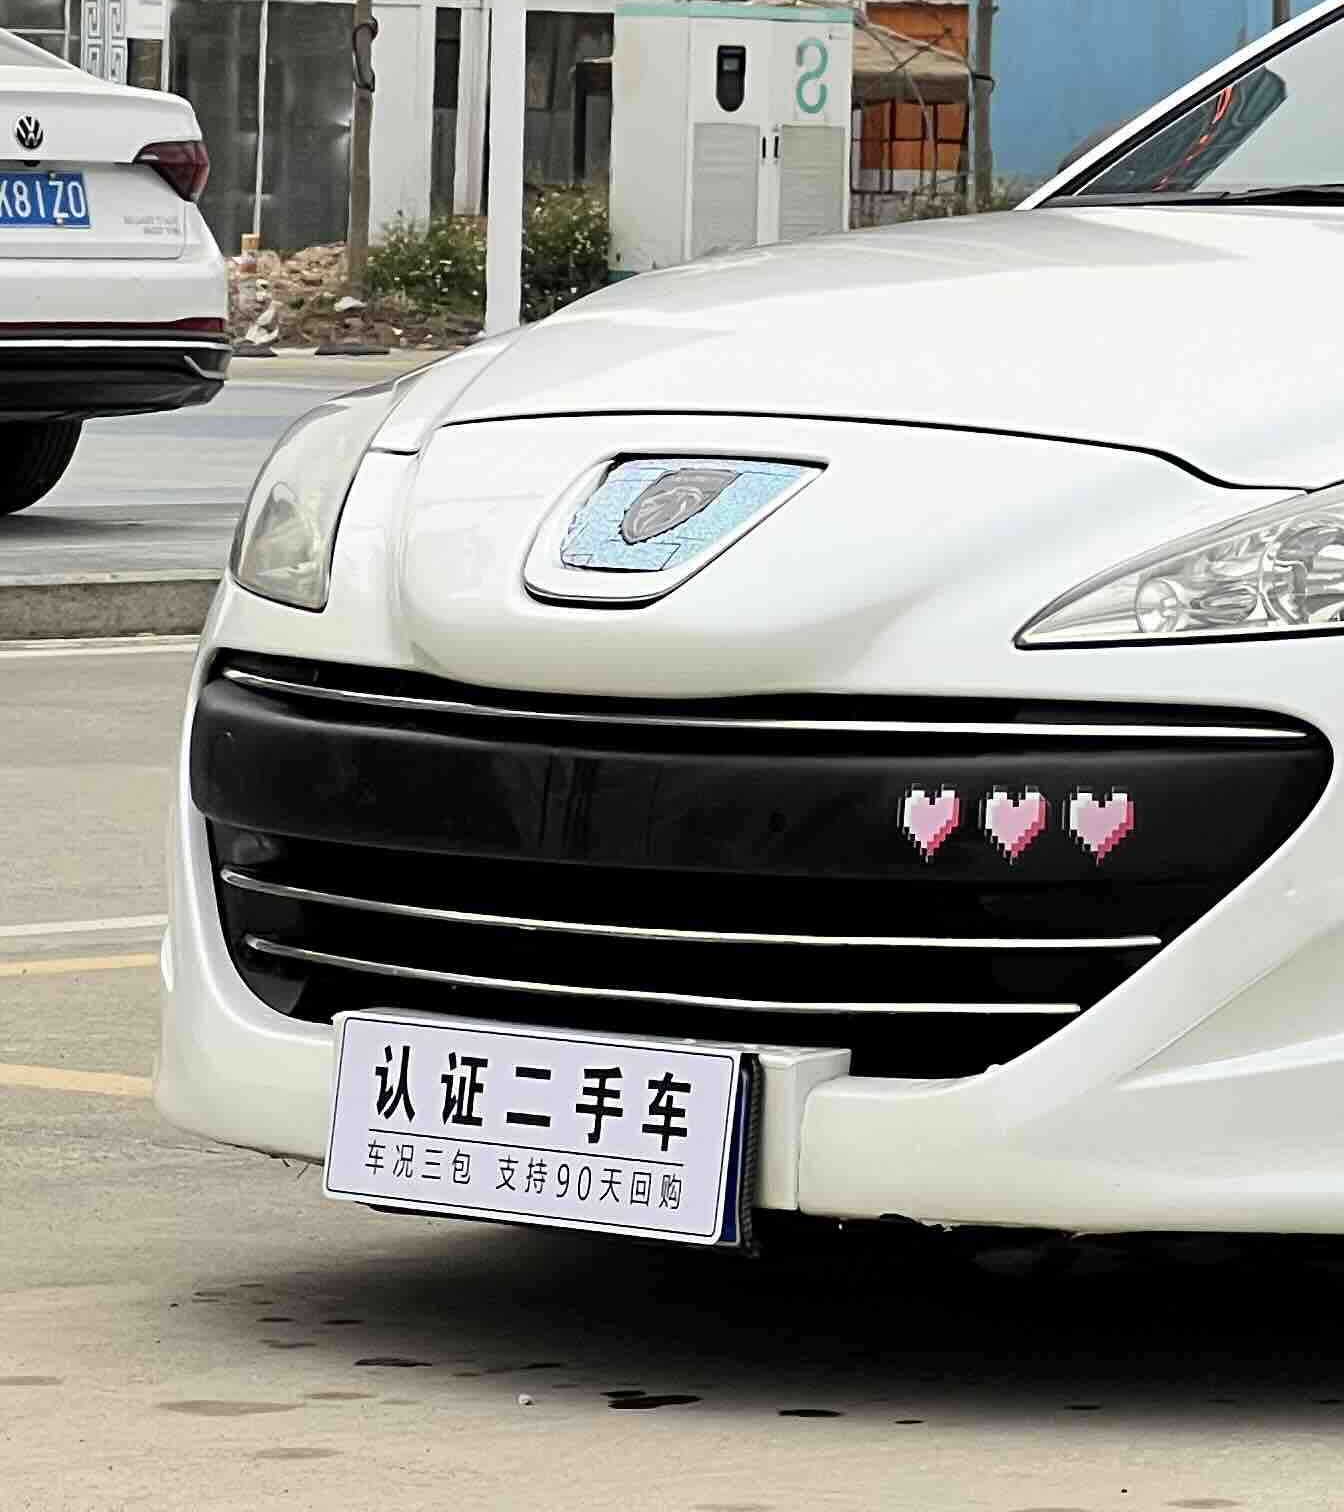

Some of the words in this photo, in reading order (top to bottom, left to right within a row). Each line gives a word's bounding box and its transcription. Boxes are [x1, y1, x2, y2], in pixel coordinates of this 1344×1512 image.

[374, 1044, 692, 1152] 认证二手车
[364, 1139, 472, 1186] 车况三包
[495, 1155, 683, 1211] 支持90天回购
